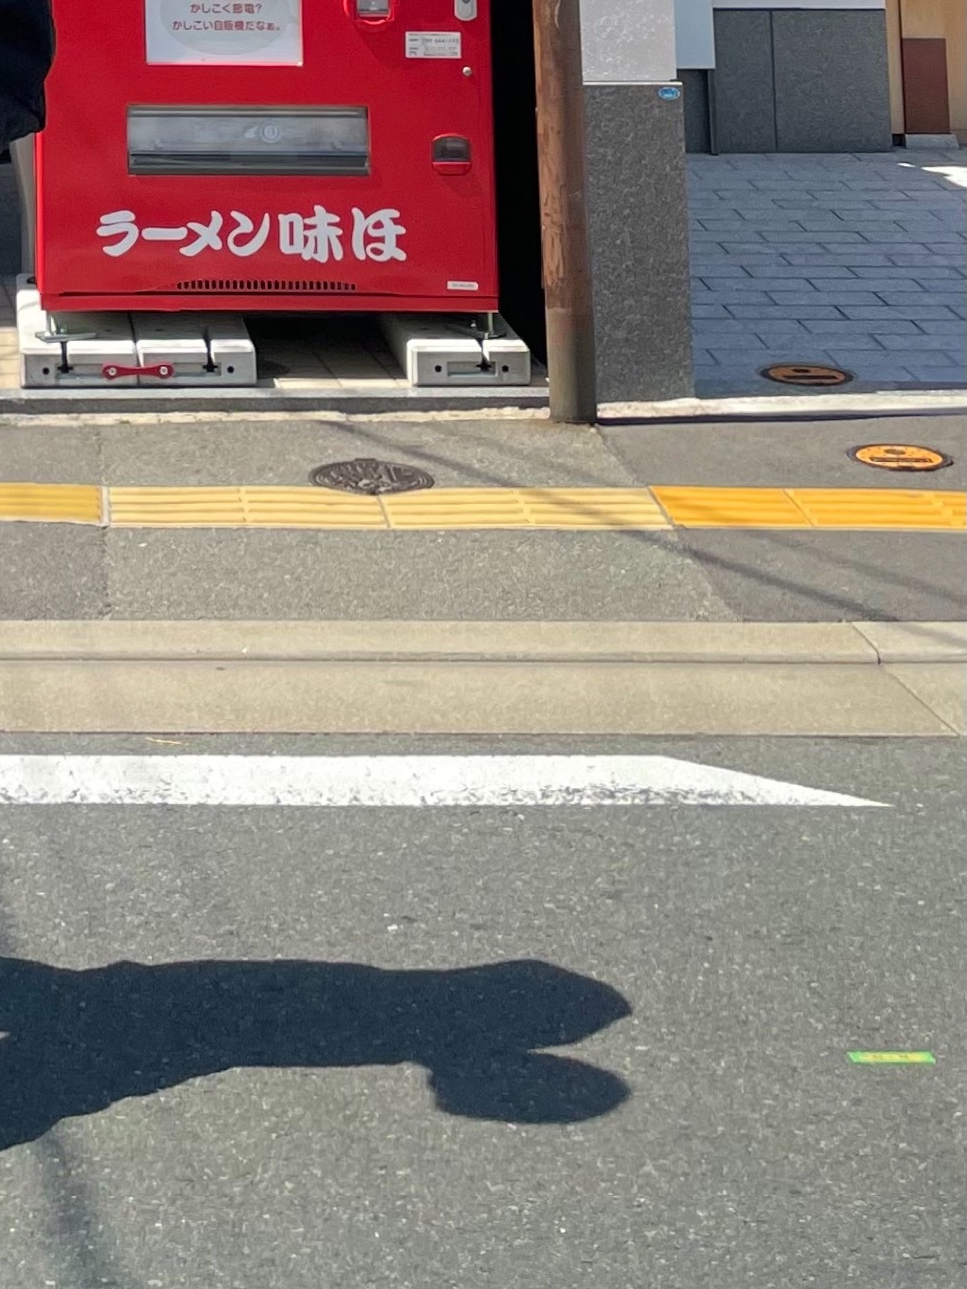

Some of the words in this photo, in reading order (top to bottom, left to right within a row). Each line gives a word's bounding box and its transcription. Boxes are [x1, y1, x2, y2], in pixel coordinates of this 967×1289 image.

[96, 204, 407, 263] ラーメン味ほ
